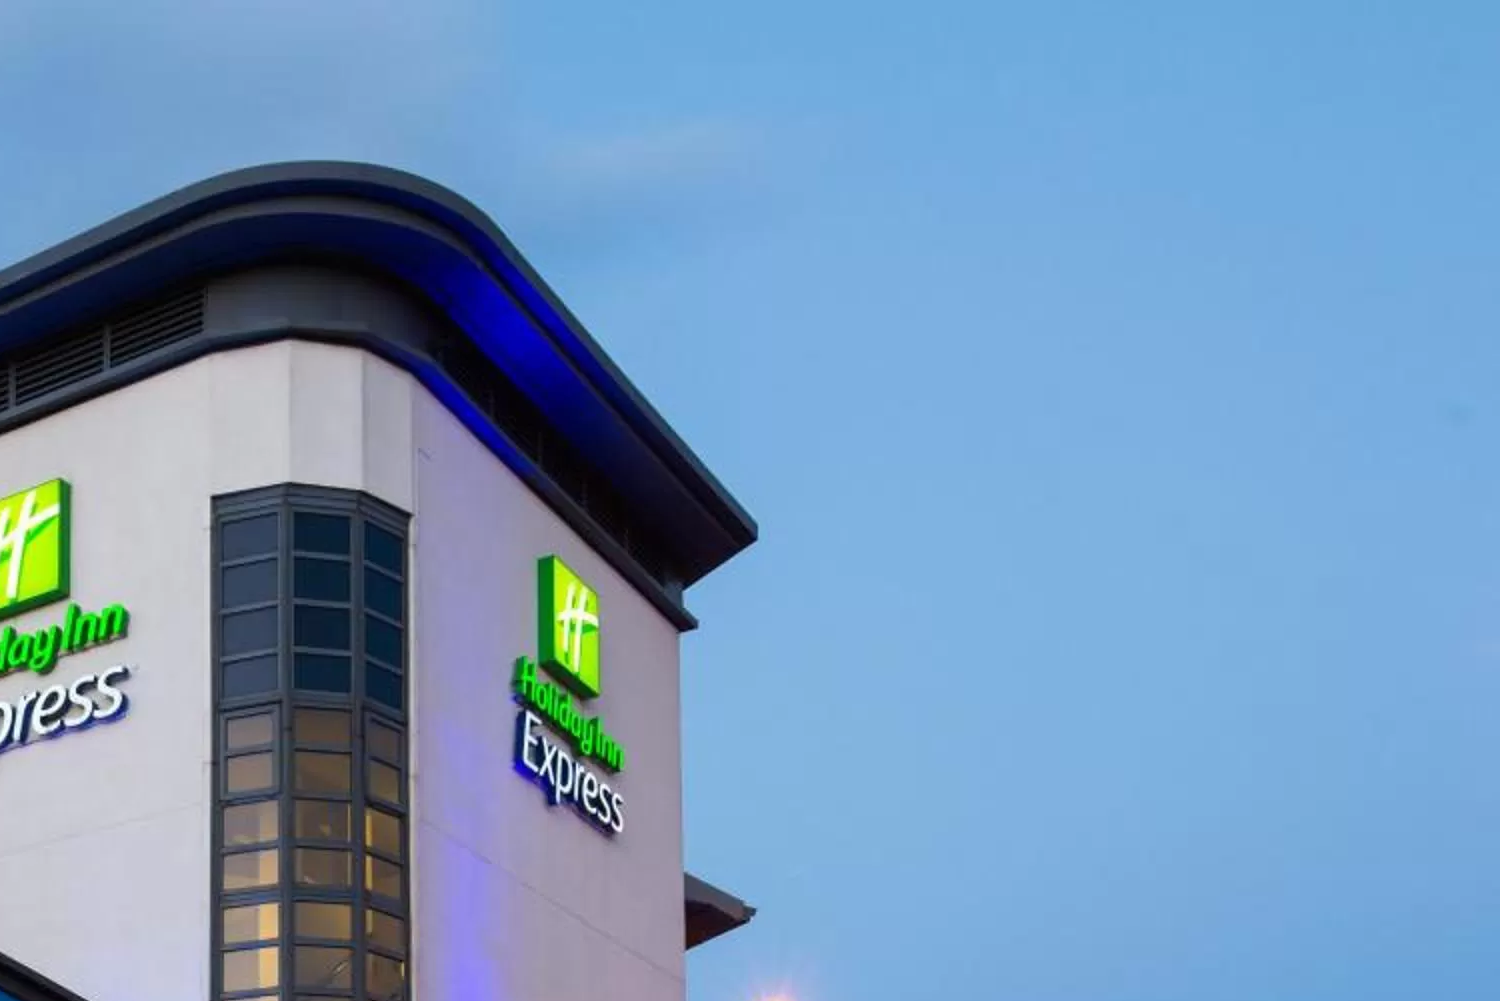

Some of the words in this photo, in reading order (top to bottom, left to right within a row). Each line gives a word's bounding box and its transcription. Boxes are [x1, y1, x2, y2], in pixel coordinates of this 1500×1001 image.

[62, 602, 130, 652] Inn
[512, 656, 597, 756] Holiday
[593, 716, 625, 772] Inn
[520, 709, 625, 834] Express
